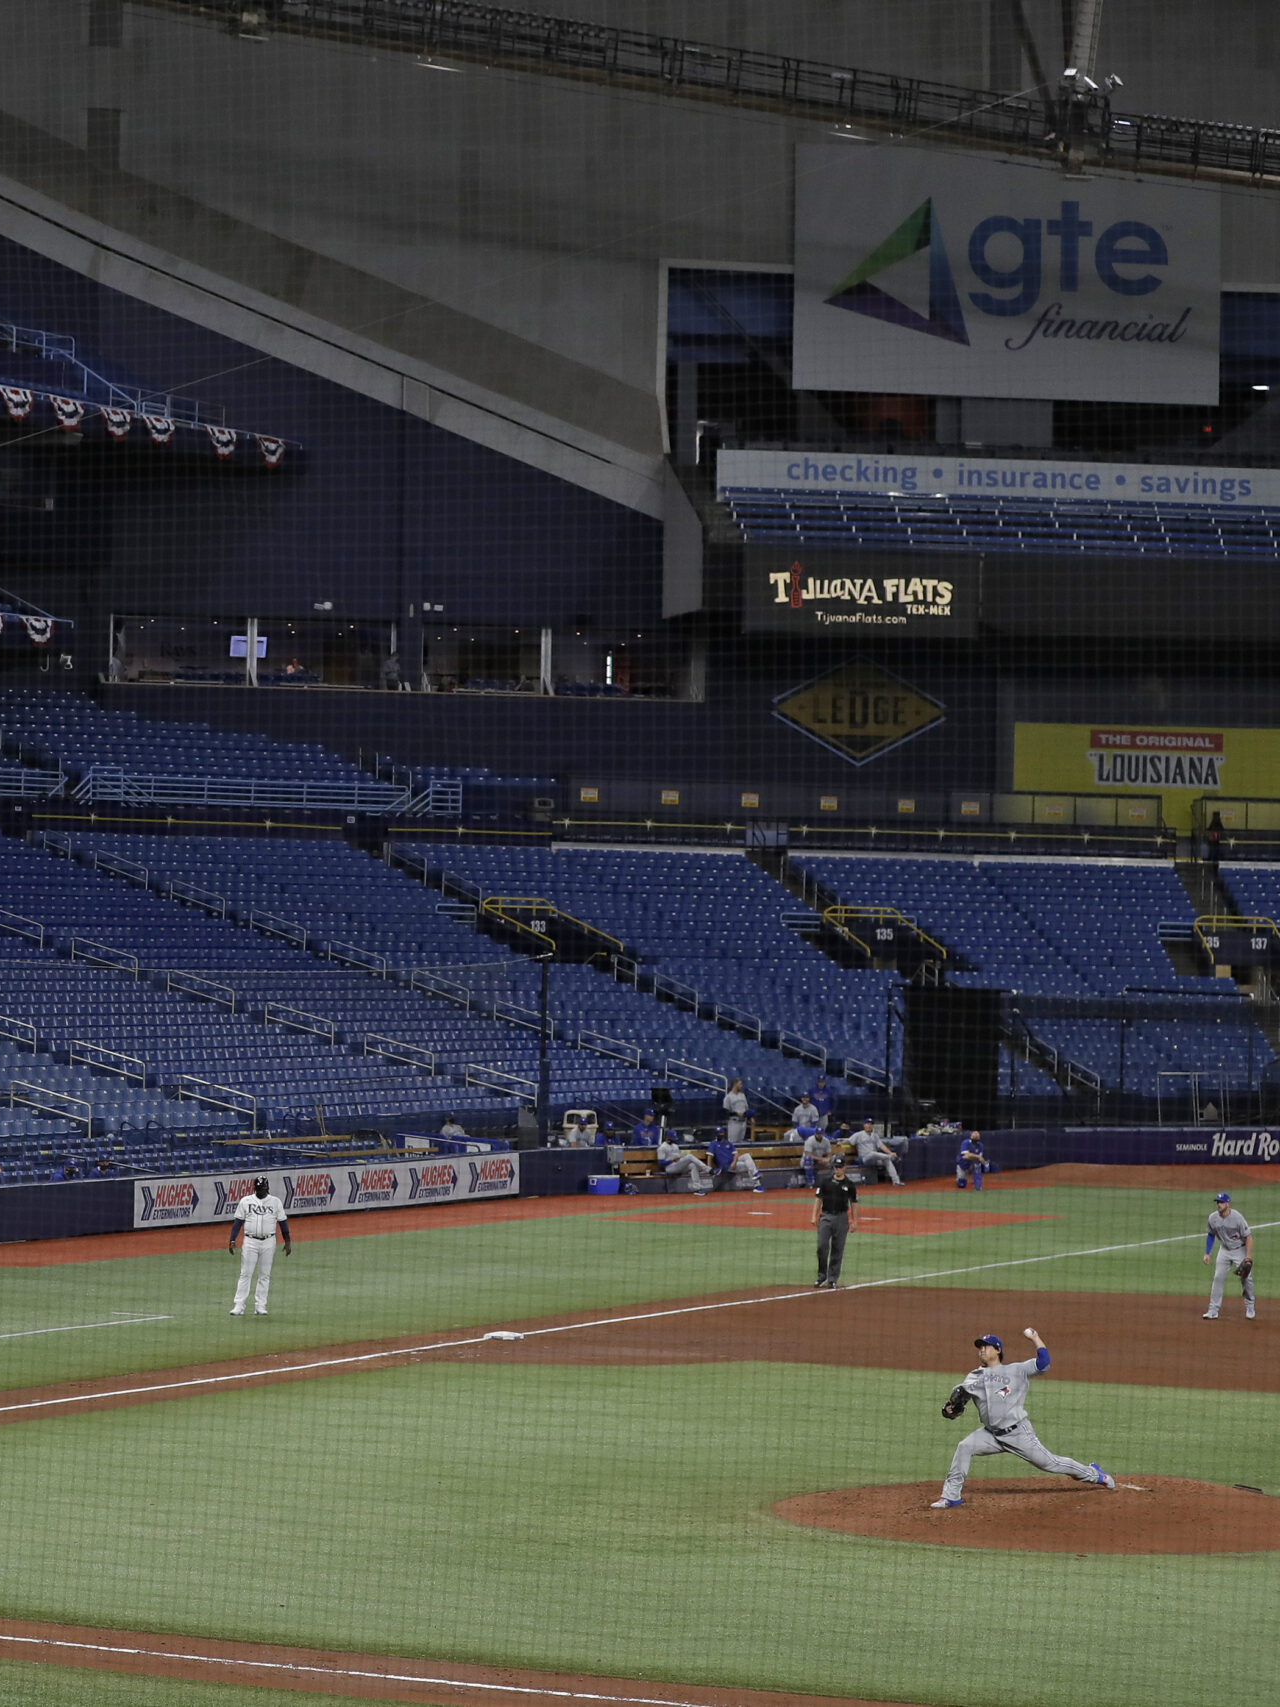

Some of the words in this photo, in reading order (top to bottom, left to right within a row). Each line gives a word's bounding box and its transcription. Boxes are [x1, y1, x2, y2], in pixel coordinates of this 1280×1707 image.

[968, 200, 1169, 316] gte
[1004, 302, 1192, 350] financial
[787, 457, 917, 490] checking
[957, 463, 1101, 489] insurance
[1140, 472, 1252, 501] savings
[883, 577, 953, 605] FLATS
[815, 611, 907, 625] TijuanaFlats.com
[905, 604, 951, 616] TEX-MEX
[812, 689, 908, 729] LEDGE
[1098, 733, 1132, 745] THE
[1135, 734, 1215, 748] ORIGINAL
[530, 920, 546, 933] 133
[875, 928, 894, 941] 135
[1250, 937, 1268, 950] 137
[1176, 1143, 1207, 1151] SEMINOLE
[1211, 1132, 1256, 1157] Hard
[359, 1169, 393, 1191] HUGHES
[420, 1164, 453, 1187] HUGHES
[479, 1159, 511, 1181] HUGHES
[155, 1183, 193, 1208] HUGHES
[295, 1174, 331, 1197] HUGHES
[153, 1207, 191, 1220] EXTERMINATORS
[248, 1203, 274, 1215] RAYS
